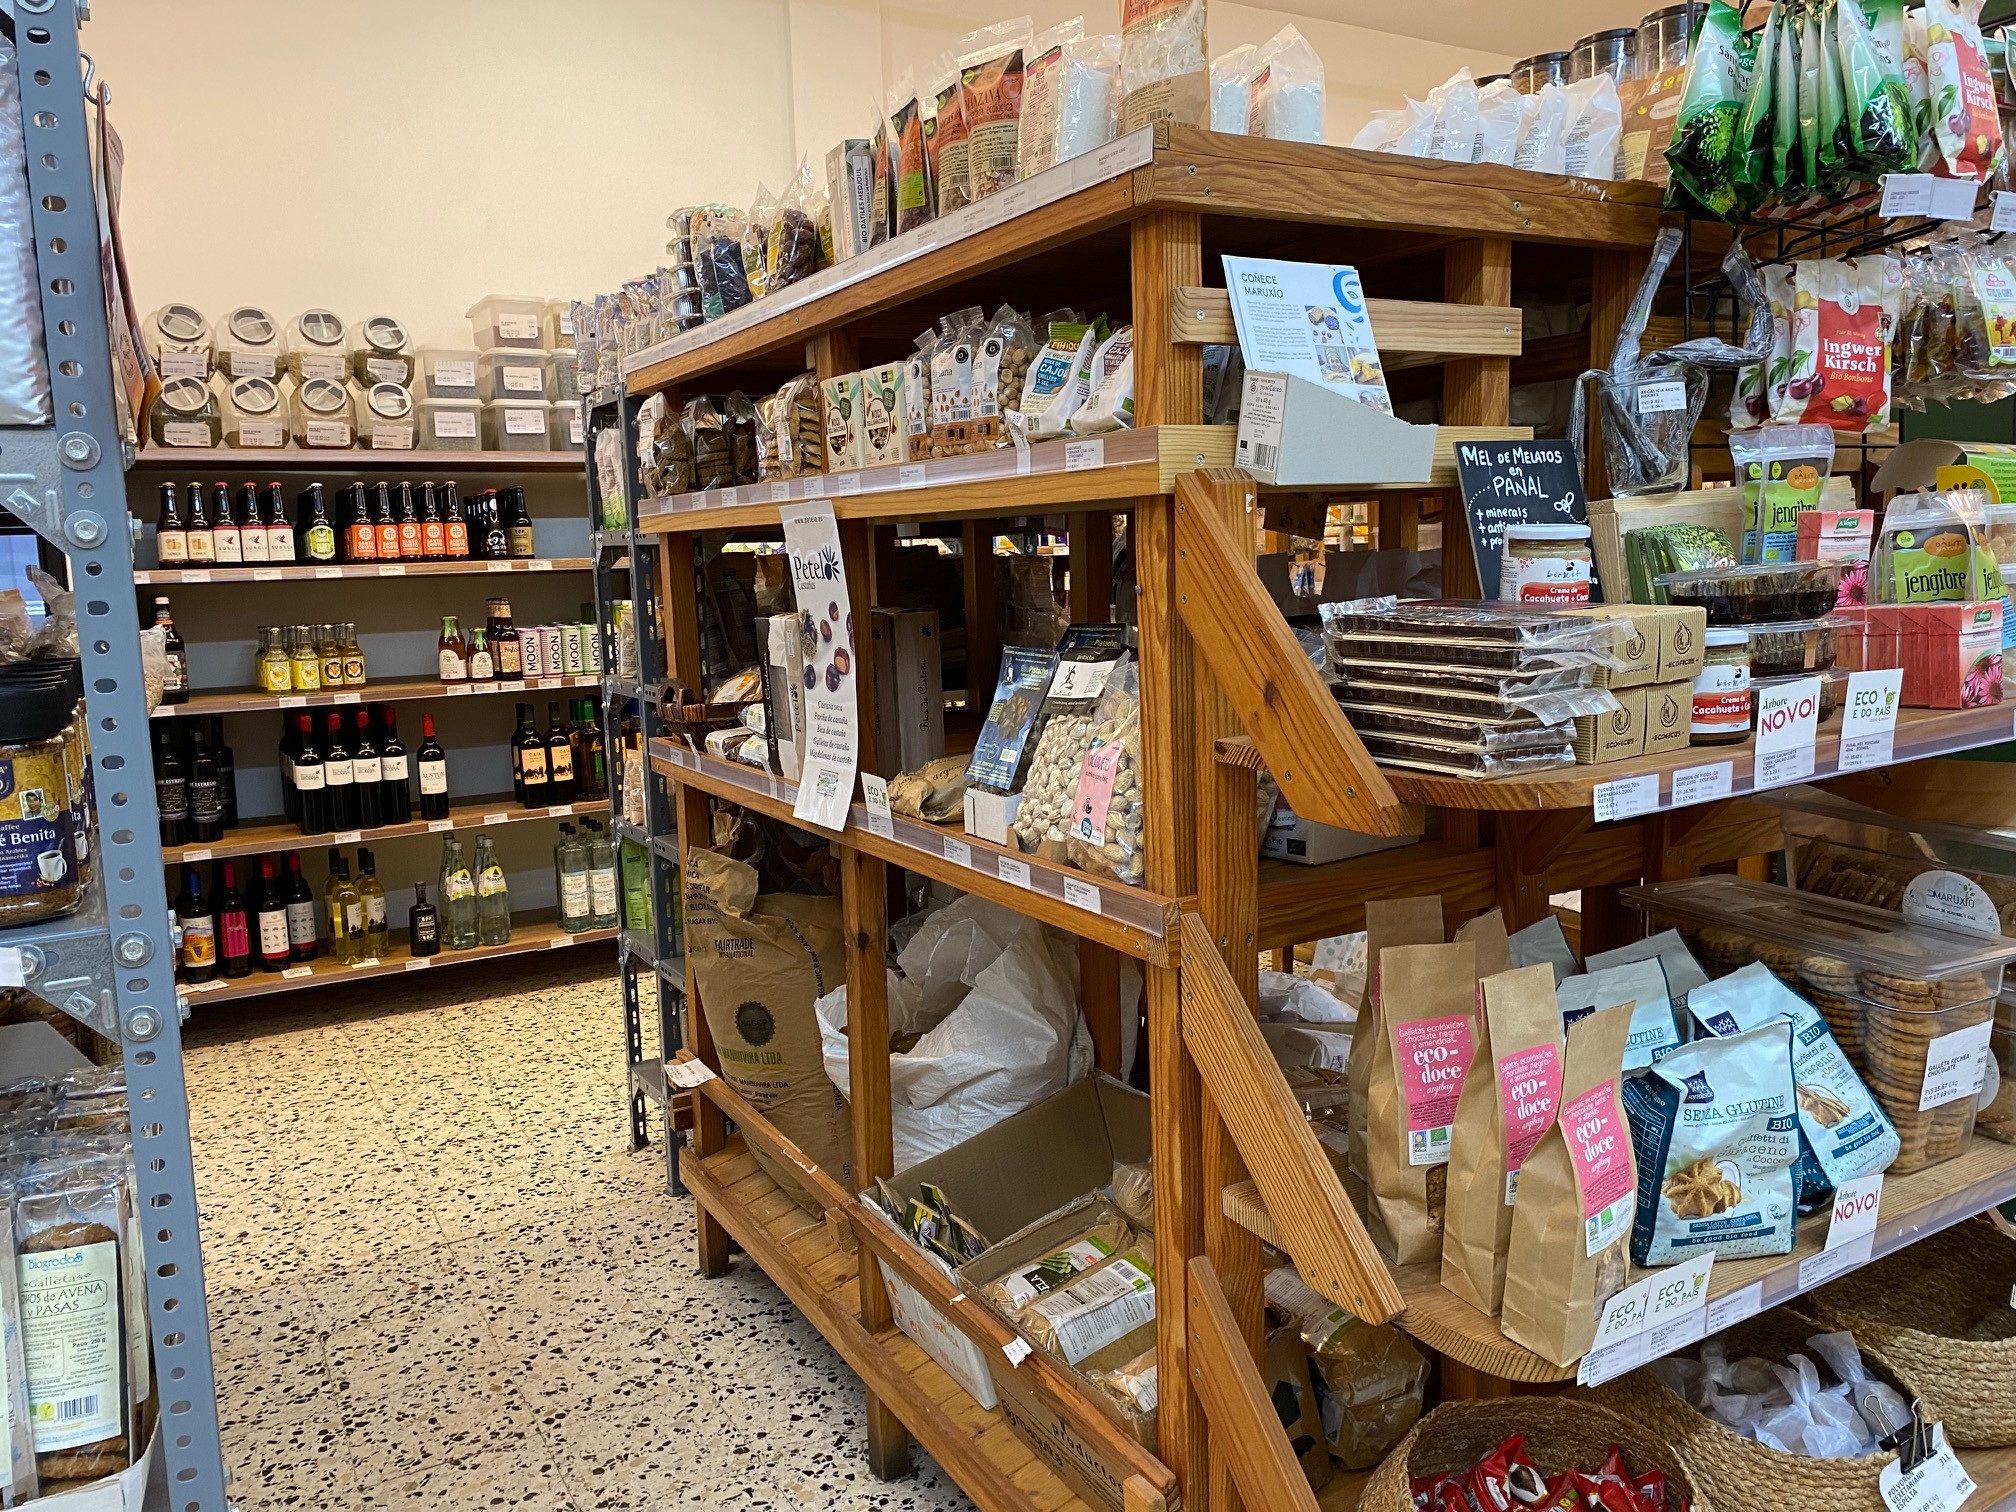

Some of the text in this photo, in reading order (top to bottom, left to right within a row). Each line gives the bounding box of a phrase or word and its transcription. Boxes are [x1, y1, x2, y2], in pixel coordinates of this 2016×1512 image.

[855, 168, 864, 201] MEDJOUL
[858, 201, 867, 231] DÁTILES
[1241, 272, 1277, 285] COÑECE
[1244, 286, 1284, 298] MARUXÍO
[1823, 338, 1882, 358] Ingwer
[1824, 354, 1877, 373] Kirsch
[1829, 372, 1873, 384] Bio Bonbons
[1460, 445, 1563, 467] MEL DE MELATOS
[1508, 466, 1523, 477] en
[1492, 476, 1549, 499] PANAL
[1905, 568, 1966, 599] jengibre
[1524, 594, 1569, 602] Cacahuete
[525, 637, 537, 671] MOON
[550, 635, 561, 670] MOON
[569, 634, 579, 668] MOON
[1721, 696, 1737, 704] Crema
[1762, 697, 1788, 710] Árbore
[1855, 690, 1878, 707] ECO
[1693, 704, 1740, 715] Cacahuete
[1761, 694, 1816, 736] NOVO!
[1853, 704, 1891, 719] E DO PAÍS
[827, 714, 833, 722] de
[833, 716, 848, 725] castaña
[831, 728, 846, 738] castaña
[829, 740, 834, 748] de
[834, 742, 850, 752] castaña
[832, 753, 837, 761] de
[867, 785, 879, 797] ECO
[10, 829, 56, 846] Benita
[714, 937, 754, 952] FAIRTRADE
[809, 951, 820, 968] RAW
[1399, 1021, 1464, 1038] Galletas ecolóxicas
[1405, 1029, 1460, 1044] chocolate negro
[1801, 1025, 1820, 1044] BIO
[1418, 1037, 1456, 1049] amendoas
[1819, 1041, 1829, 1053] di
[761, 1051, 787, 1065] LTDA.
[1530, 1060, 1549, 1072] negro
[1796, 1051, 1836, 1082] araceno
[1928, 1053, 1970, 1071] GALLETA RECHEA
[1421, 1063, 1462, 1084] doce
[1927, 1064, 1956, 1078] CHOCOLATE
[1923, 1091, 1947, 1102] PVP 17.03
[1924, 1083, 1948, 1096] PVS 15.67
[1517, 1097, 1551, 1120] doce
[1725, 1095, 1785, 1118] GLUTINE
[1771, 1118, 1793, 1130] BIO
[1778, 1132, 1790, 1143] di
[1584, 1135, 1615, 1163] doce
[1834, 1190, 1878, 1224] NOVO!
[1703, 1234, 1723, 1243] good
[1725, 1232, 1738, 1240] bio
[1740, 1230, 1758, 1238] food
[28, 1275, 82, 1288] Galletas
[44, 1283, 103, 1303] de AVENA
[1657, 1280, 1685, 1301] ECO
[28, 1299, 80, 1317] y PASAS
[1655, 1286, 1700, 1313] E DO PAÍS
[1608, 1300, 1635, 1323] ECO
[1604, 1318, 1627, 1334] E DO
[1938, 1453, 1950, 1467] 311
[1891, 1470, 1925, 1504] VEXETARIANO
[1896, 1488, 1918, 1511] ESPELTA
